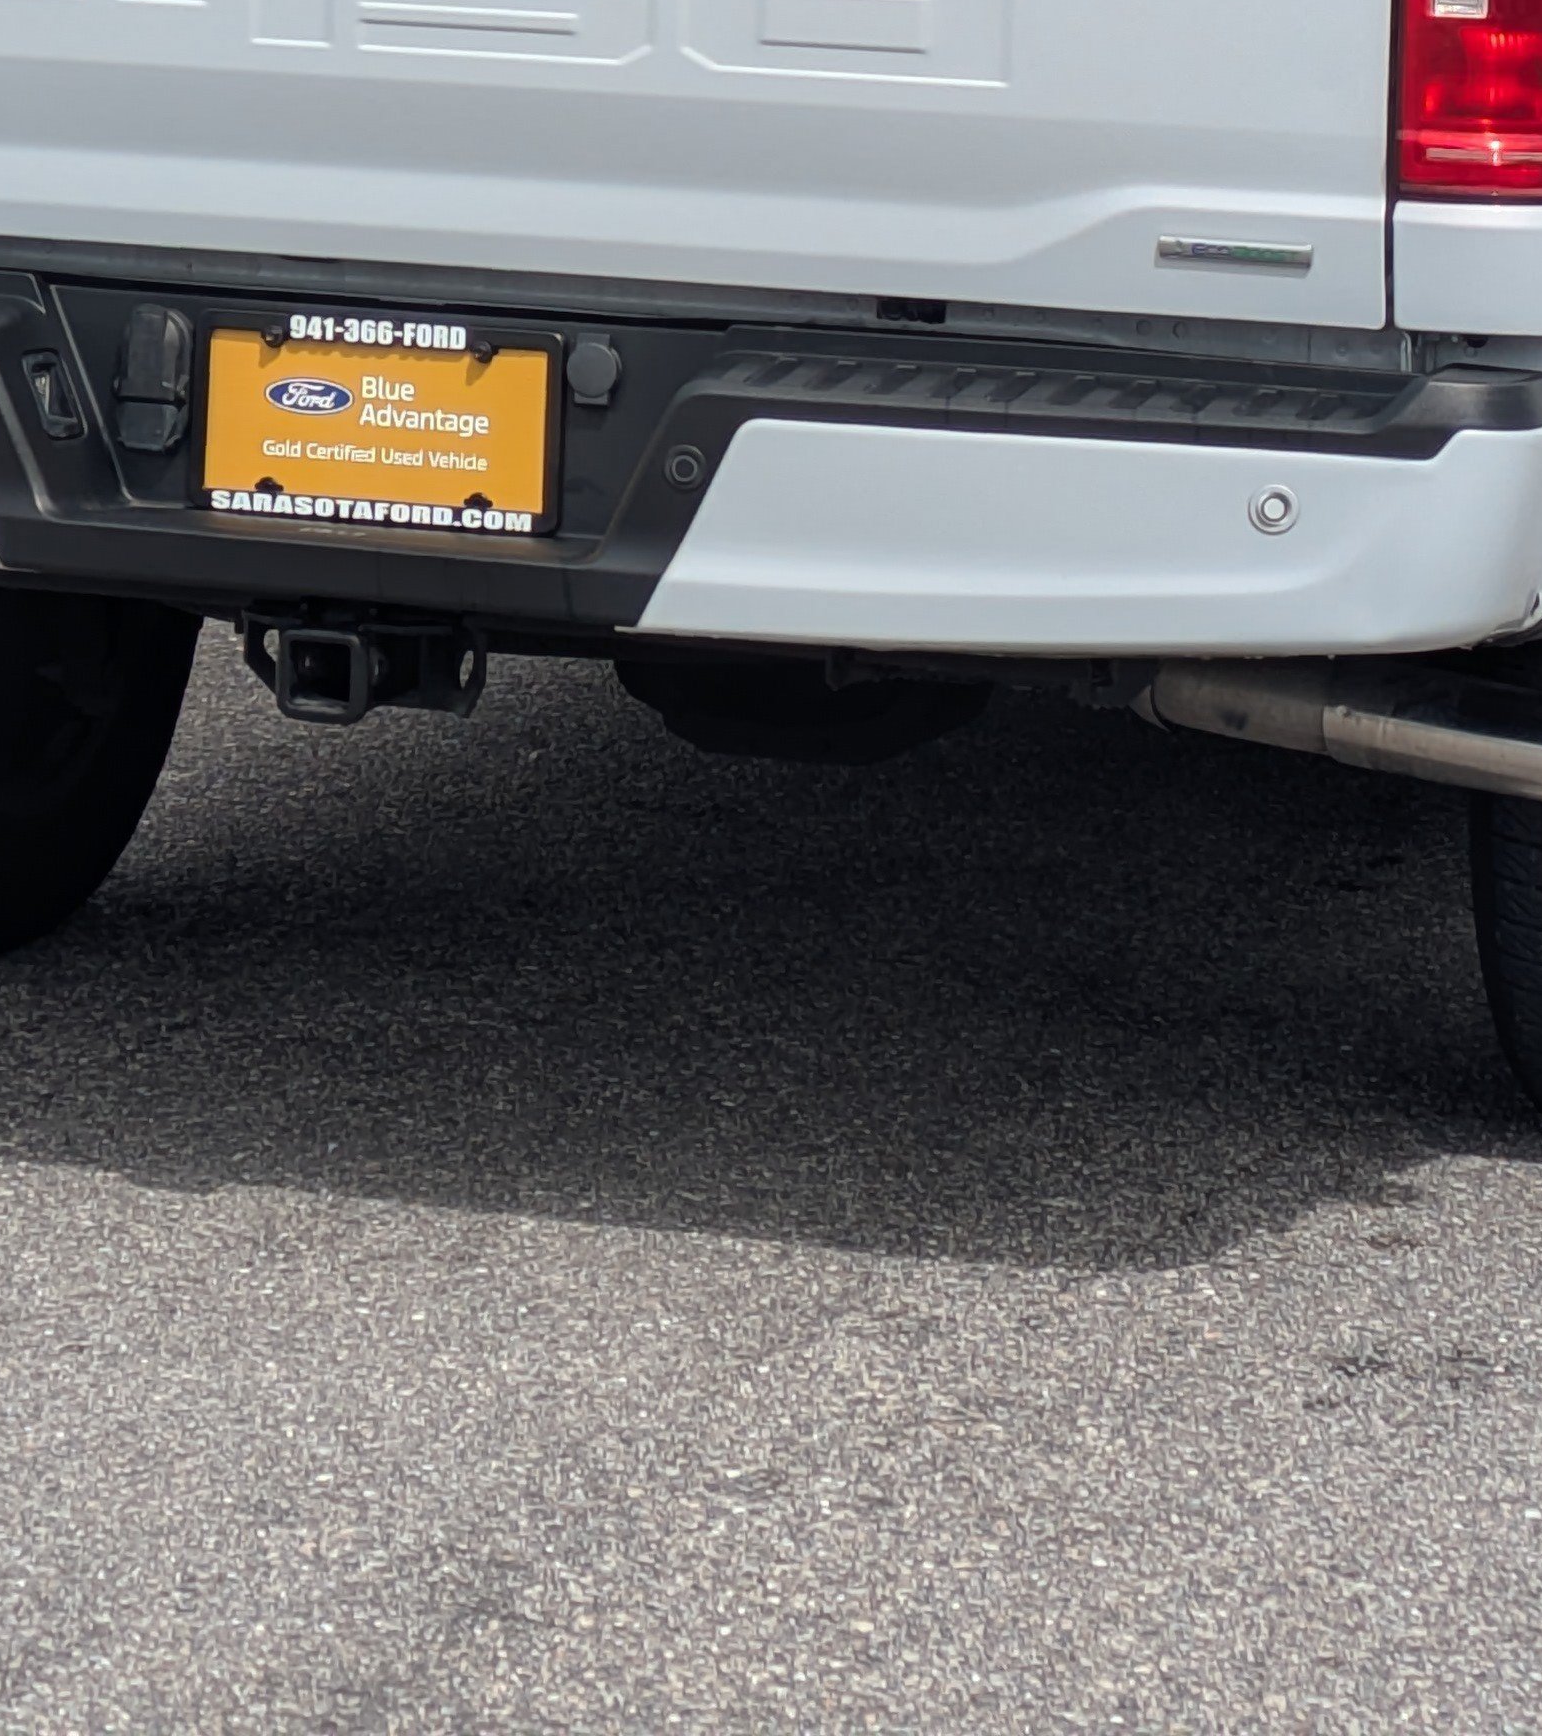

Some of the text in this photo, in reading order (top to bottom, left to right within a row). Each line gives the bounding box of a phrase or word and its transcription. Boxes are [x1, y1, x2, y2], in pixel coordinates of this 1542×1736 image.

[289, 314, 467, 350] 941-366-FORD
[282, 384, 336, 410] Ford
[361, 376, 415, 402] Blue
[359, 403, 489, 438] Advantage
[262, 439, 488, 472] Gold Certified Used Vehicle
[210, 489, 533, 533] SARASOTAFORD.COM
